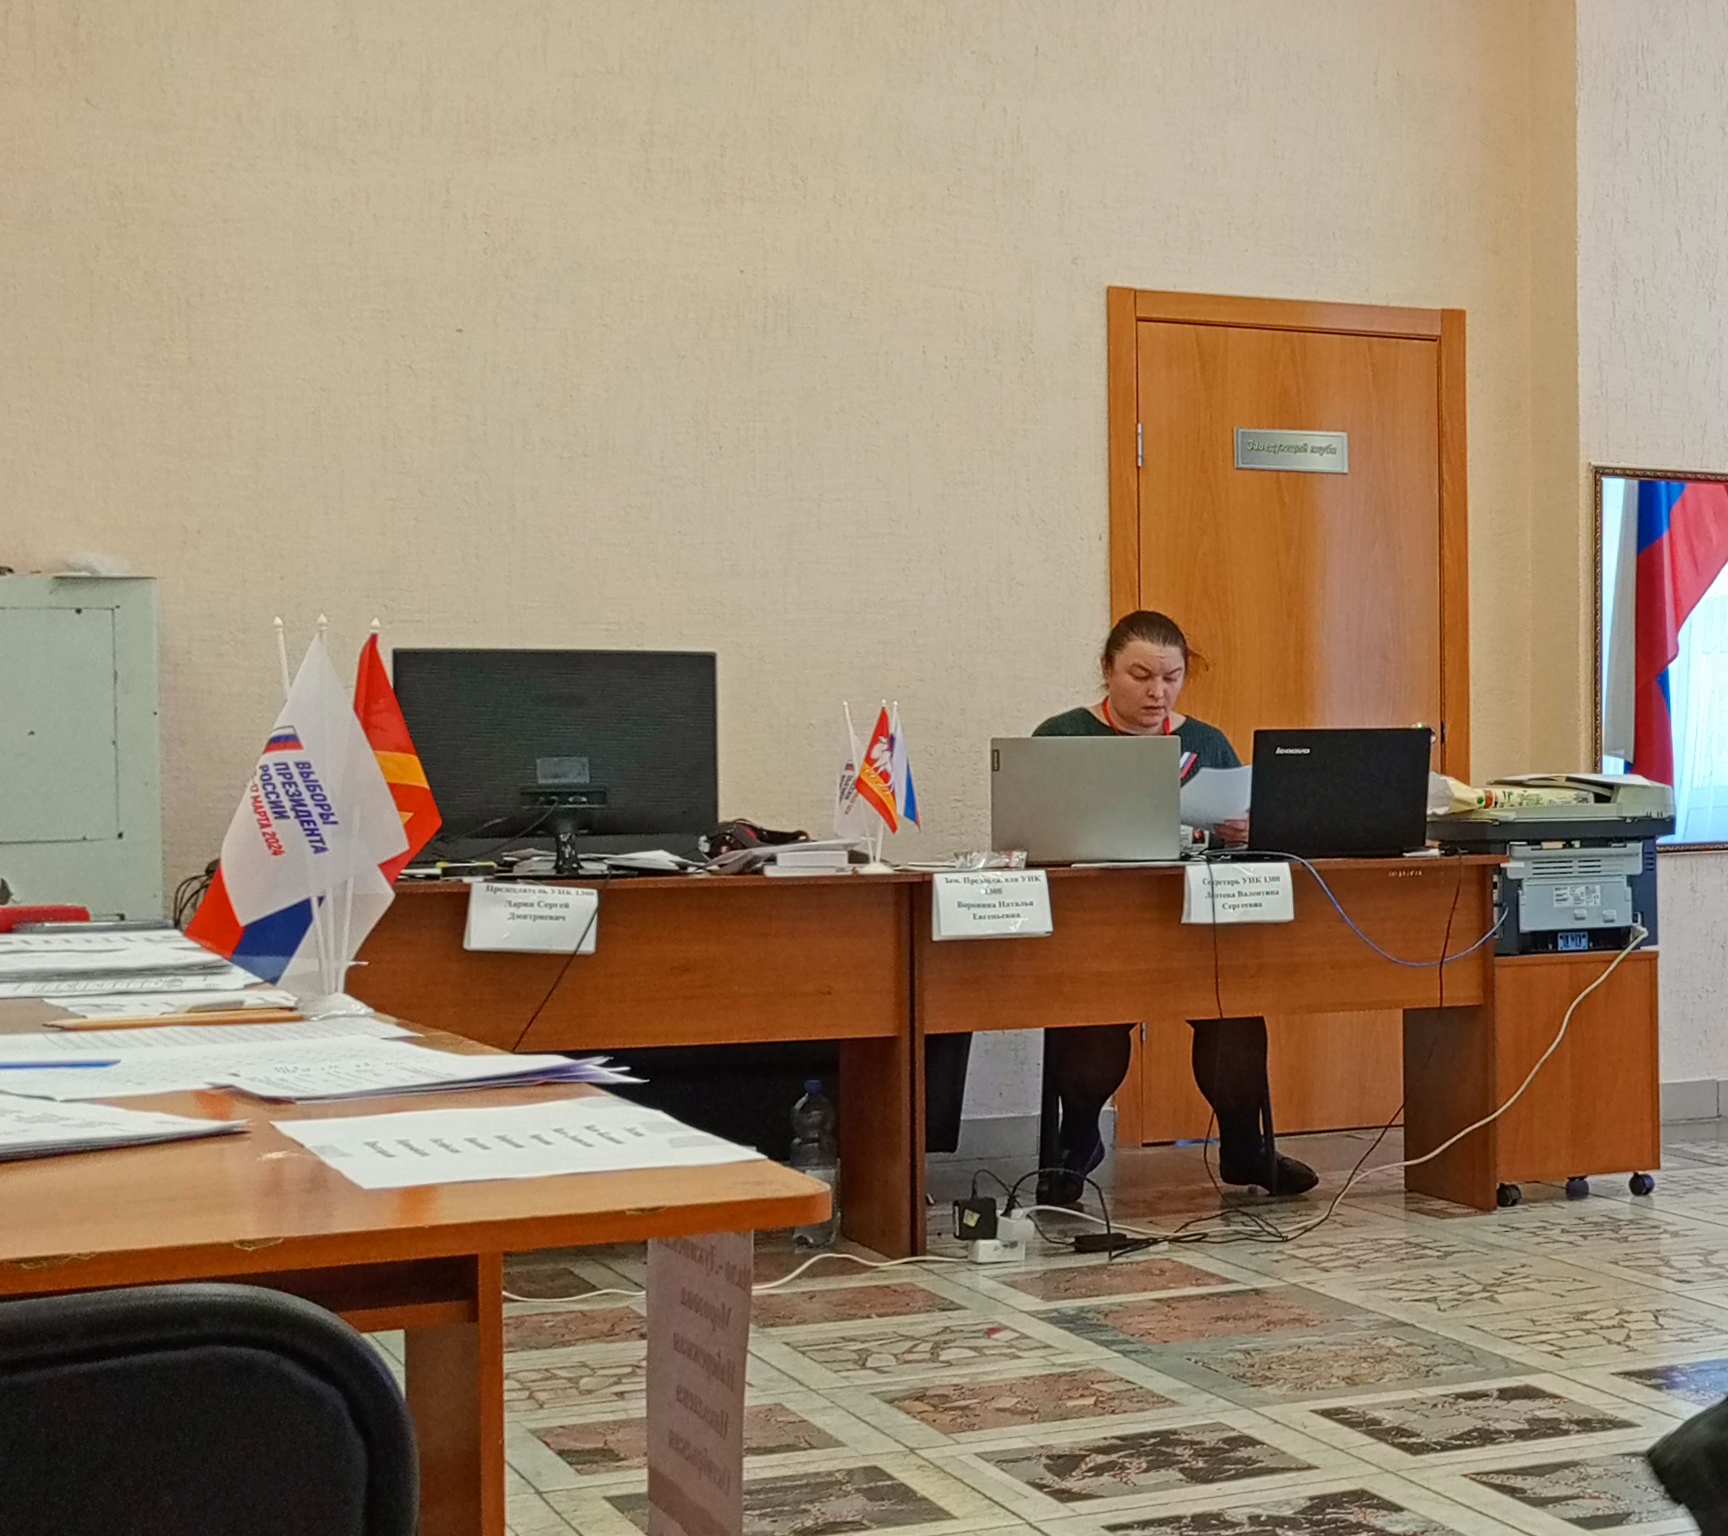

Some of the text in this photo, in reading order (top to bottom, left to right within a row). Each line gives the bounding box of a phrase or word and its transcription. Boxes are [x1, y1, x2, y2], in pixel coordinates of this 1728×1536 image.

[259, 764, 291, 820] РОССИИ
[273, 762, 329, 855] ПРЕЗИДЕНТА
[294, 761, 339, 825] ВЫБОРЫ
[251, 795, 273, 830] МАРТА
[262, 831, 286, 857] 2024
[507, 912, 566, 922] Дмитриевич
[537, 900, 570, 910] Сергей
